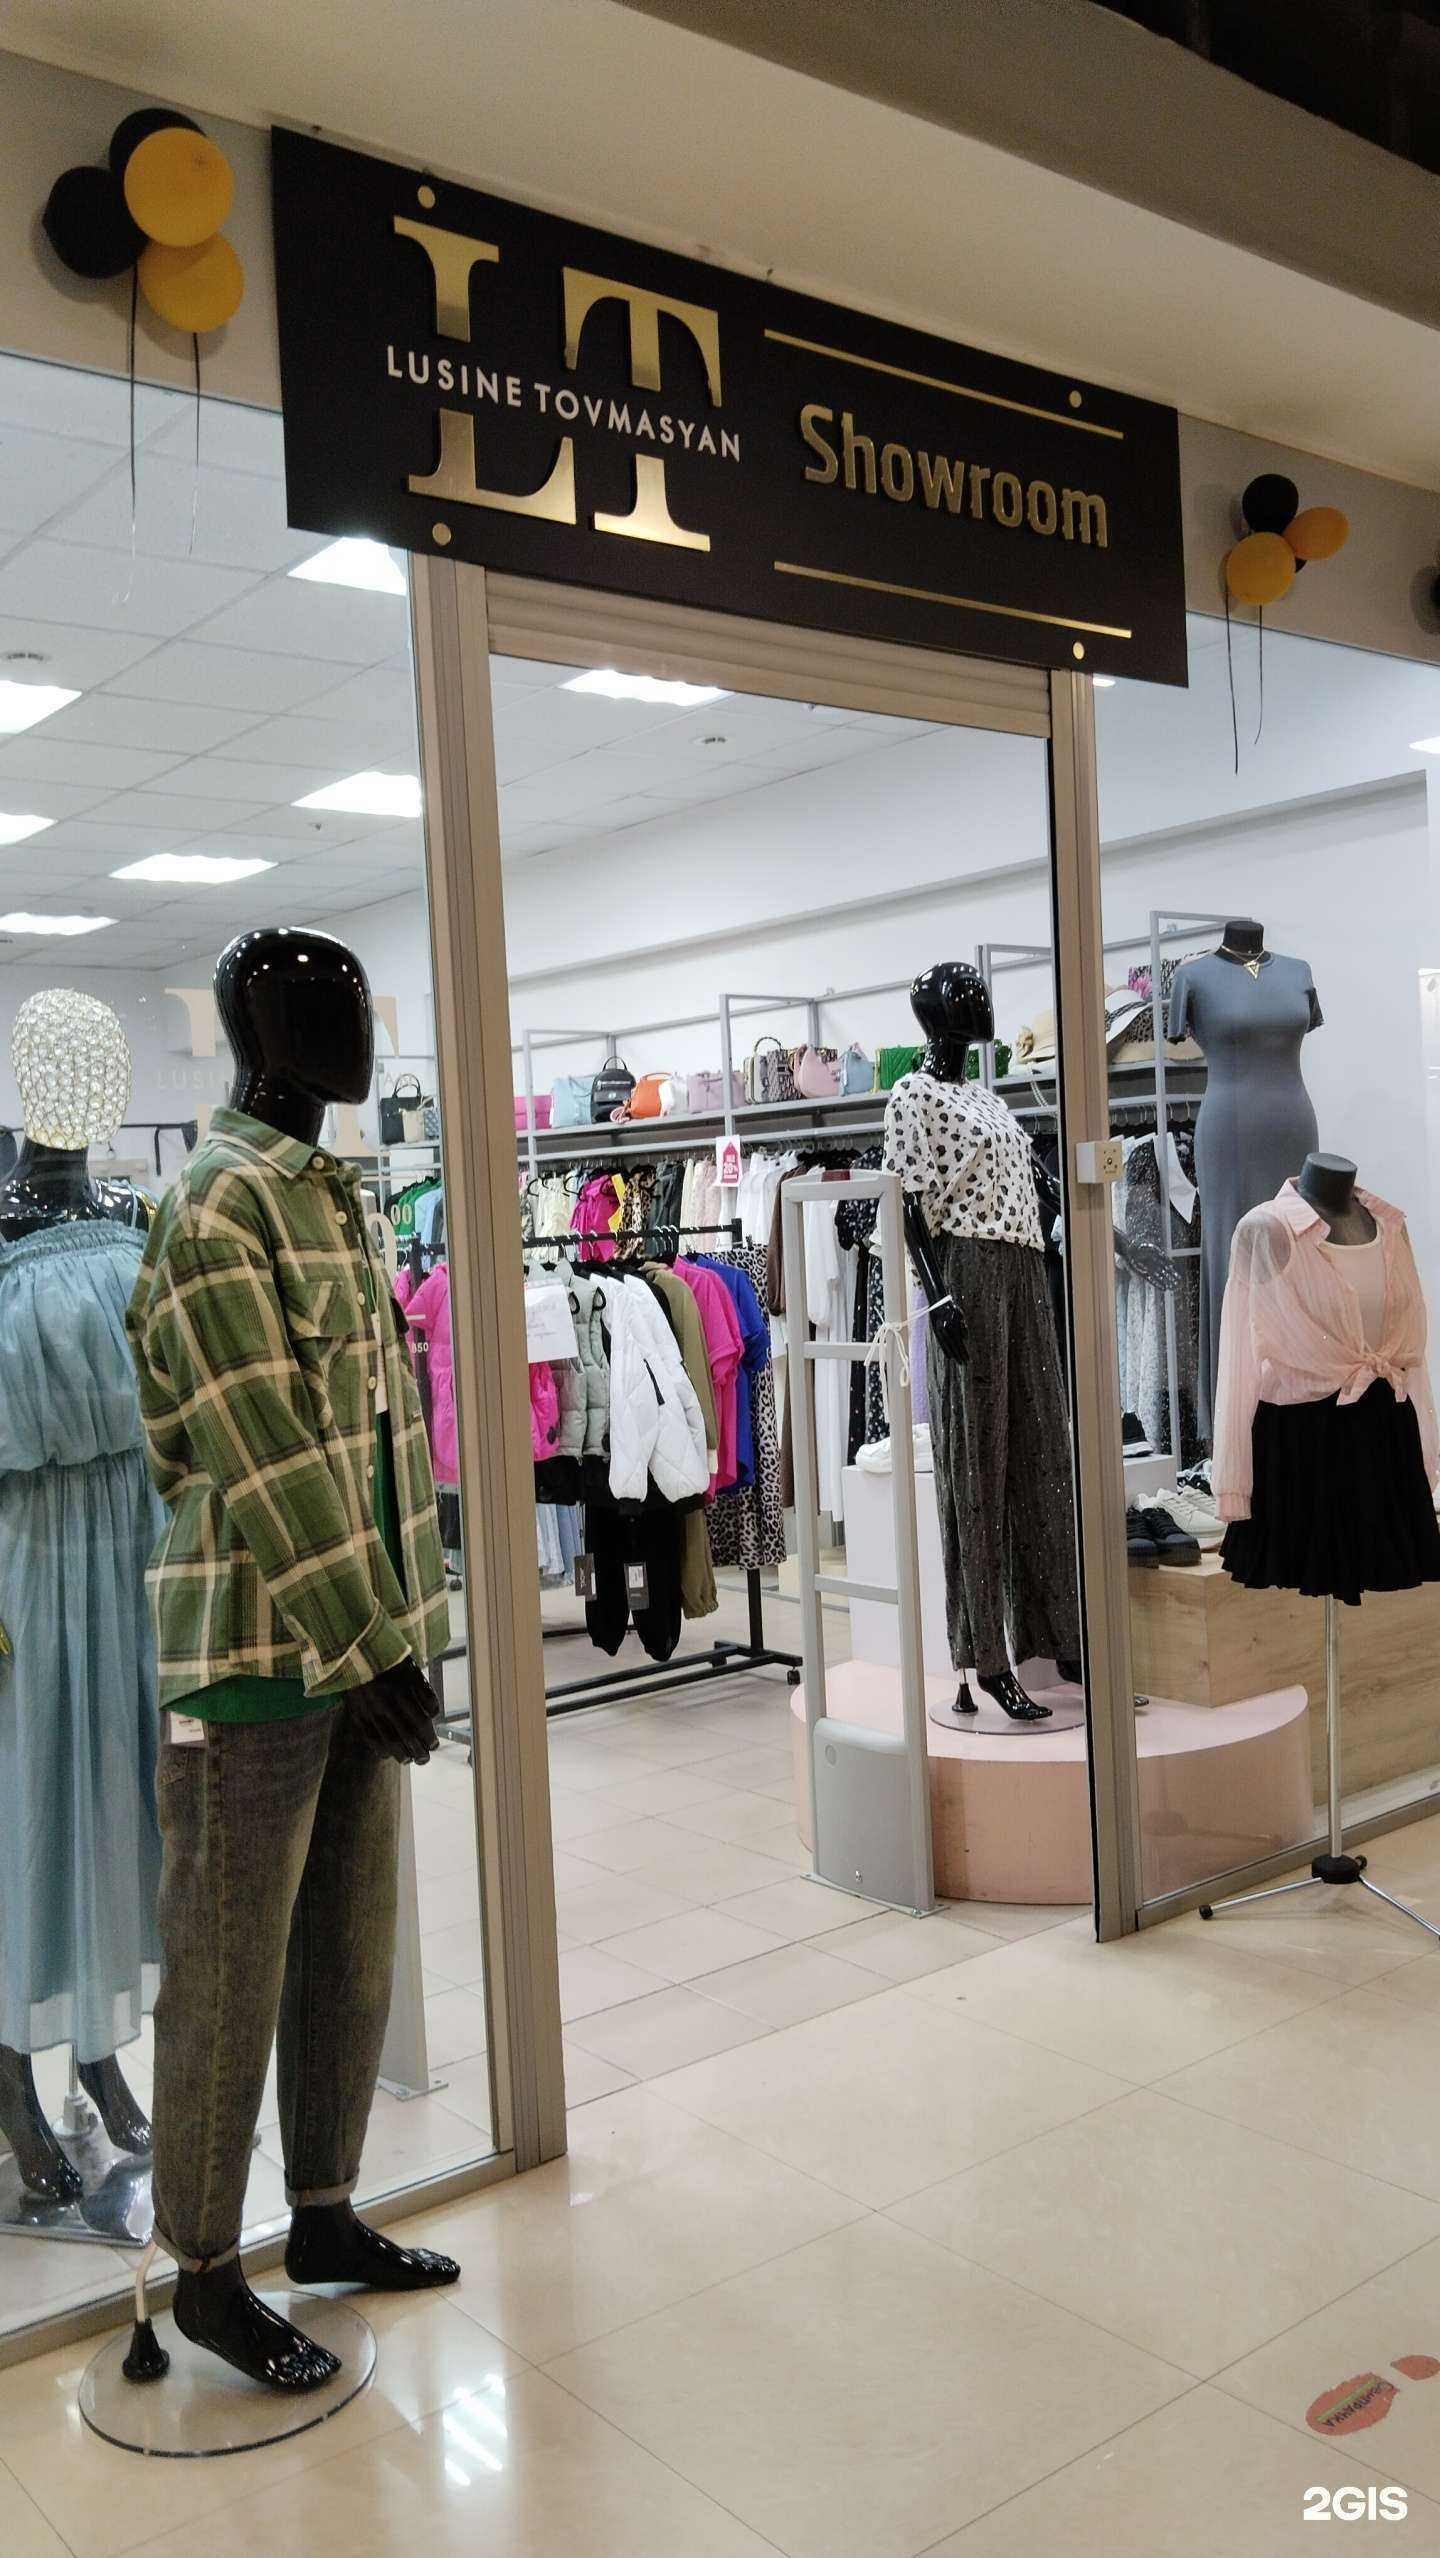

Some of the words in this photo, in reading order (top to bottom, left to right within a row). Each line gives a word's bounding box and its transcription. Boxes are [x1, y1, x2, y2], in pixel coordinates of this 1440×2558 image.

[387, 345, 522, 407] LUSINE
[534, 384, 741, 464] TOVMASYAN
[393, 215, 723, 552] LT
[799, 403, 1109, 549] Showroom
